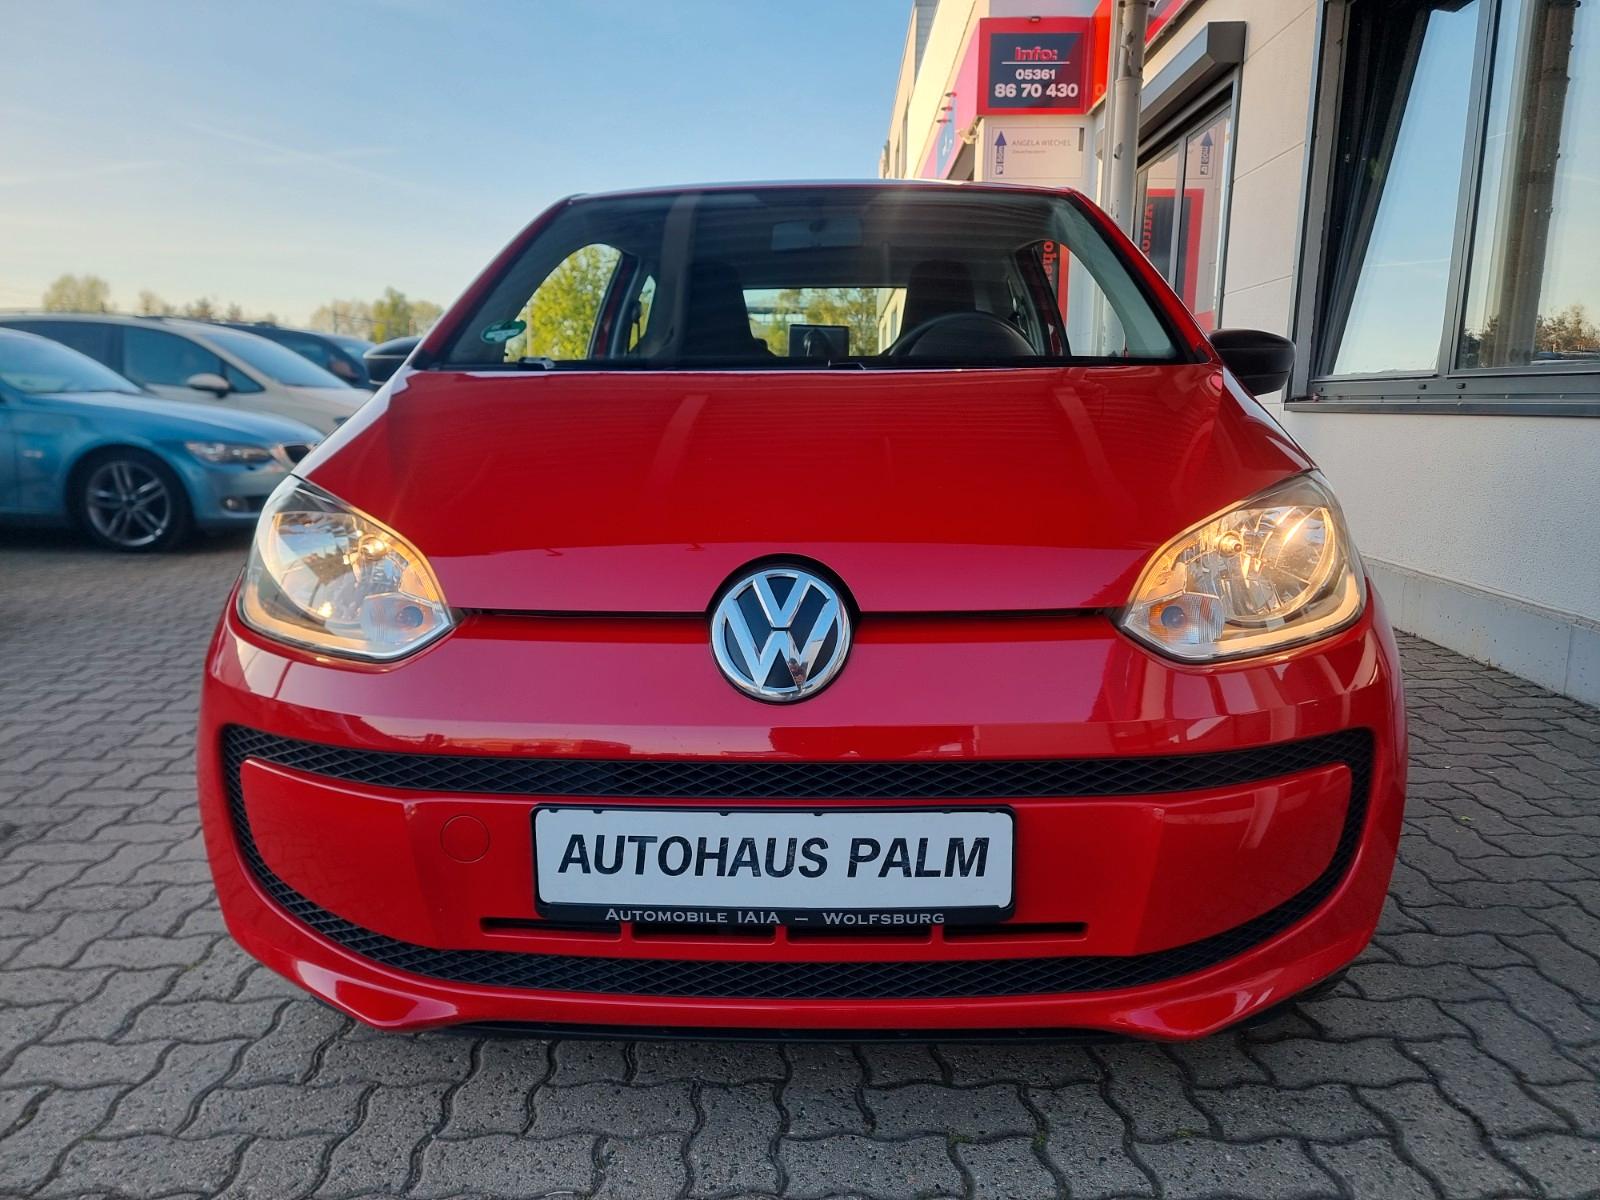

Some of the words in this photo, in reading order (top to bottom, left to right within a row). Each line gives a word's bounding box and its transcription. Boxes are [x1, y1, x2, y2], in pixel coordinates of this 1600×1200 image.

[1014, 46, 1058, 61] Info:
[1015, 69, 1056, 80] 05361
[994, 83, 1017, 98] 86
[1020, 83, 1042, 98] 70
[1046, 83, 1079, 98] 430
[557, 834, 829, 878] AUTOHAUS
[847, 837, 990, 878] PALM
[737, 911, 781, 924] IAIA
